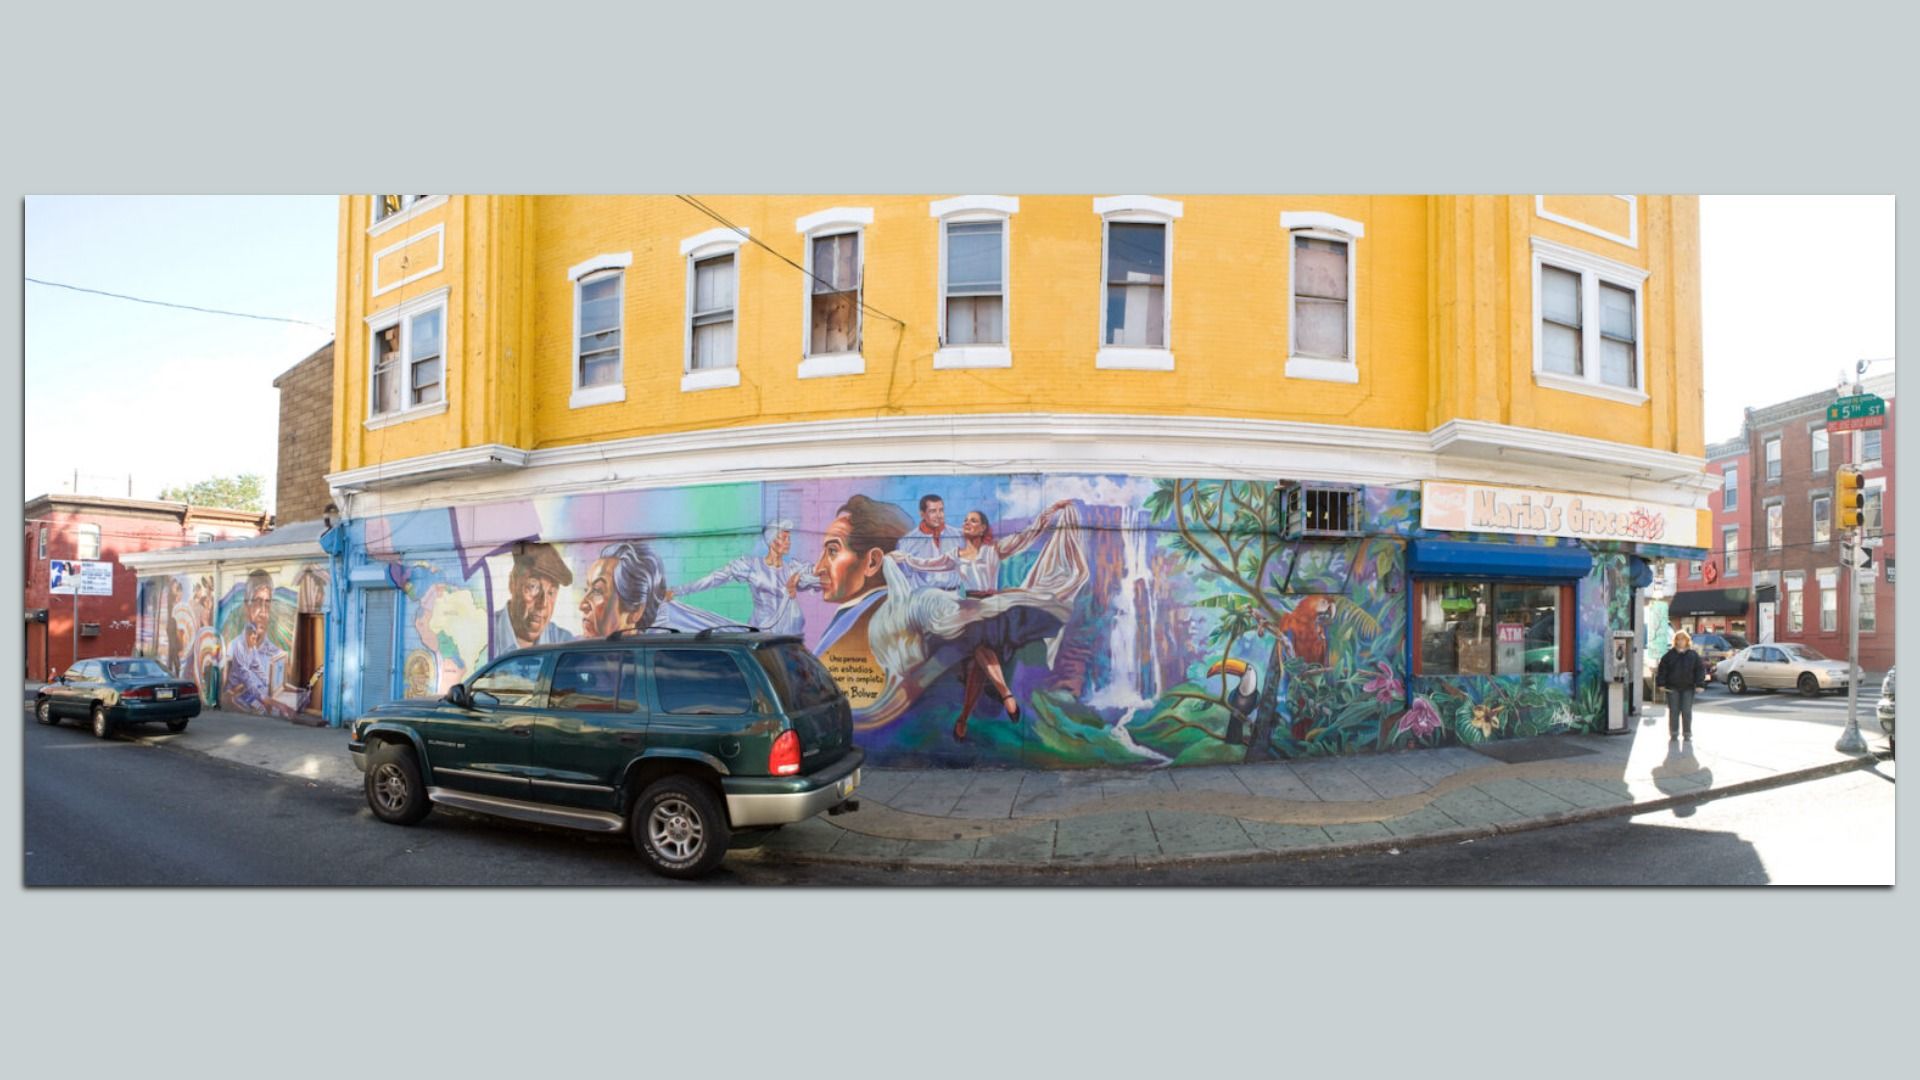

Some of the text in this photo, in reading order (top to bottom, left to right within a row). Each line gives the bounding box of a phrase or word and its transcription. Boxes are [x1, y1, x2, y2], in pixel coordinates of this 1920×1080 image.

[1869, 404, 1880, 416] ST
[1471, 489, 1562, 533] Maria's
[1499, 627, 1521, 640] ATM
